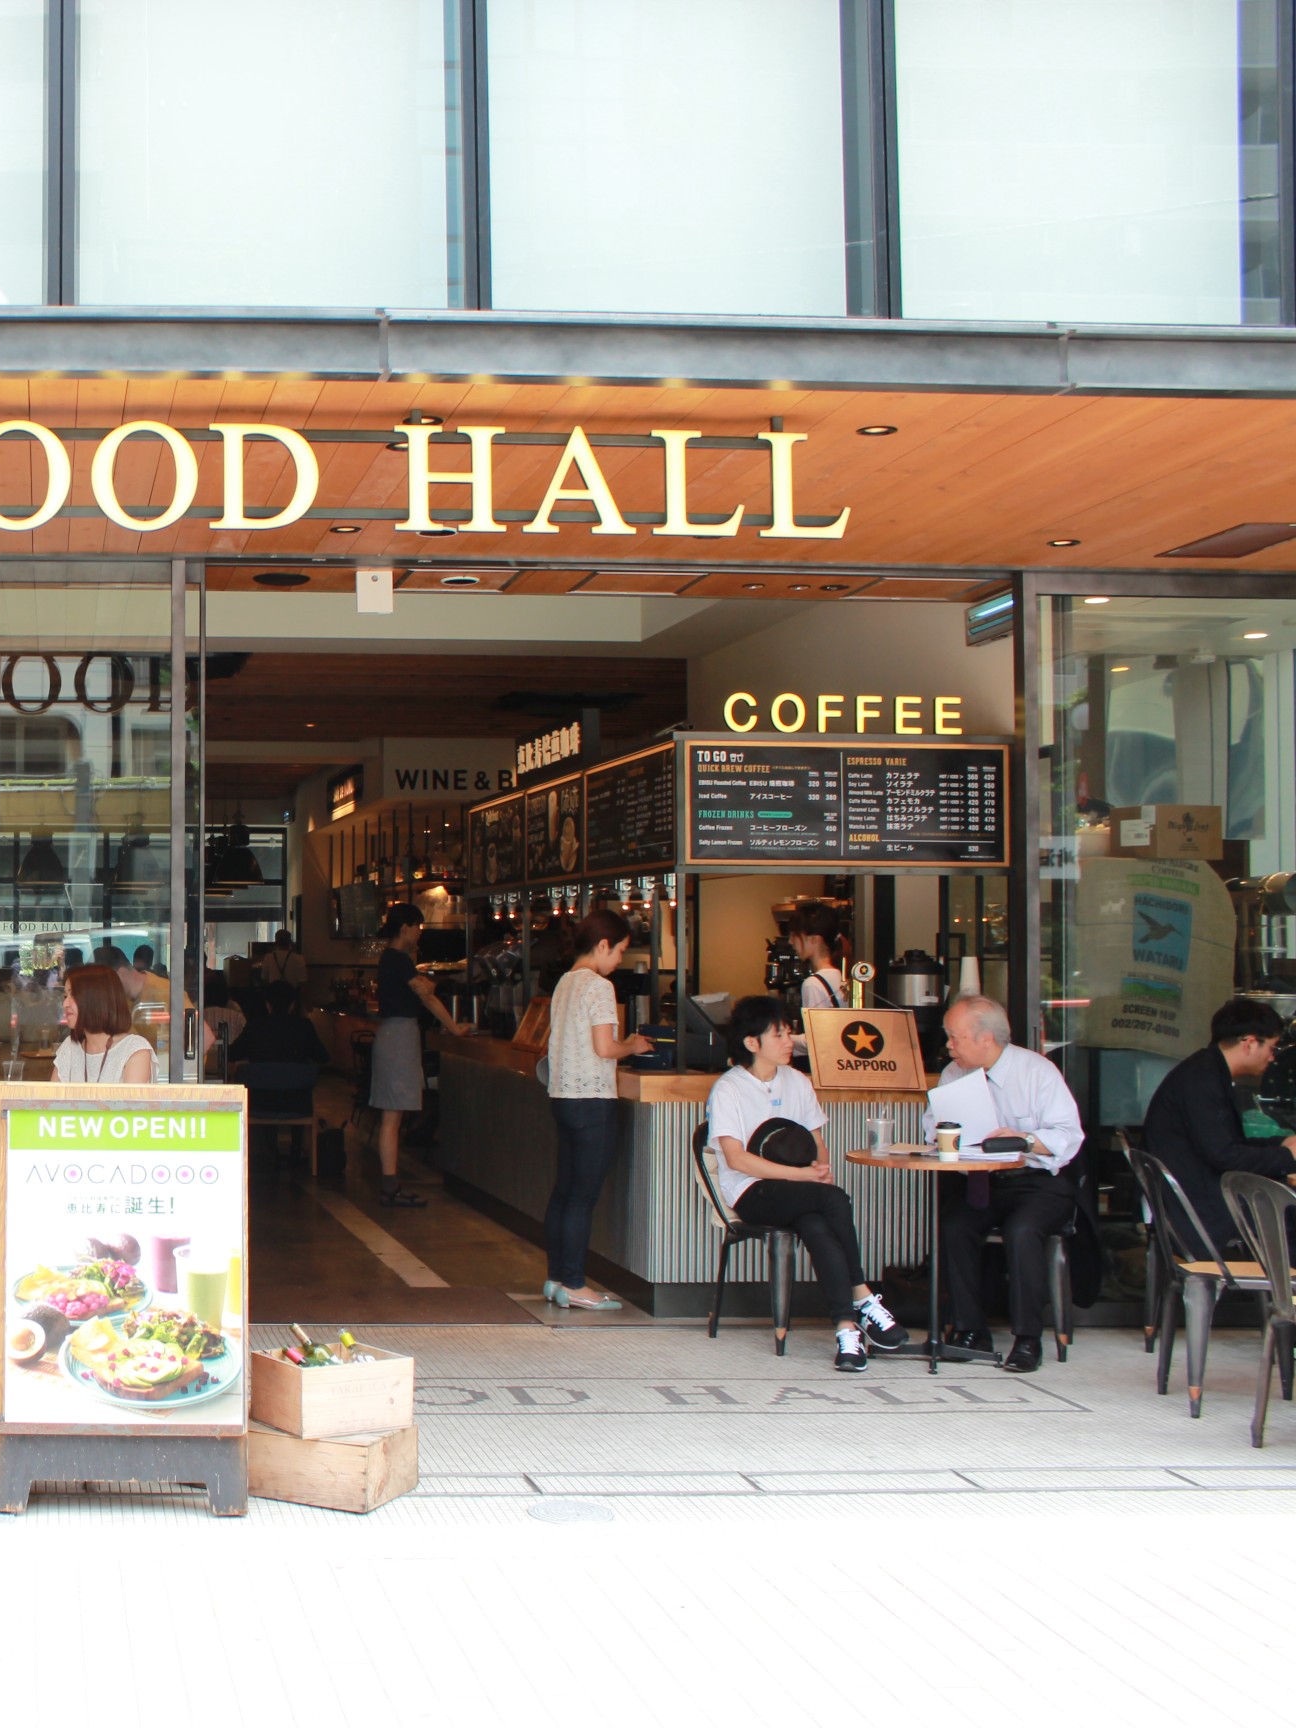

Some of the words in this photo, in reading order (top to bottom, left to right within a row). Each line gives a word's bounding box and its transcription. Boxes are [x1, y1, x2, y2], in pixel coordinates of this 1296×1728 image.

[393, 425, 851, 538] HALL
[723, 692, 963, 735] COFFEE
[696, 750, 710, 763] TO
[712, 750, 726, 763] GO
[846, 757, 883, 766] ESPRESSO
[885, 757, 908, 766] VARIE
[697, 764, 720, 773] QUICK
[720, 764, 743, 773] BREW
[743, 764, 771, 774] COFFEE
[395, 769, 468, 790] WINE
[474, 770, 490, 791] &
[498, 769, 513, 791] B
[885, 772, 921, 780] カフェラテ
[807, 780, 820, 788] 320
[886, 780, 913, 788] ソイラテ
[885, 789, 936, 797] アーモンドミルクラテ
[886, 797, 921, 805] カフェモカ
[698, 810, 726, 819] FROZEN
[727, 810, 755, 819] DRINKS
[848, 833, 881, 842] ALCOHOL
[1133, 949, 1184, 971] WATARU
[1122, 1003, 1157, 1017] SCREEN
[836, 1059, 897, 1072] SAPPORO
[39, 1115, 104, 1138] NEW
[109, 1115, 206, 1139] OPEN!!
[25, 1163, 219, 1185] AVOCADOOO
[643, 1385, 1032, 1406] HALL
